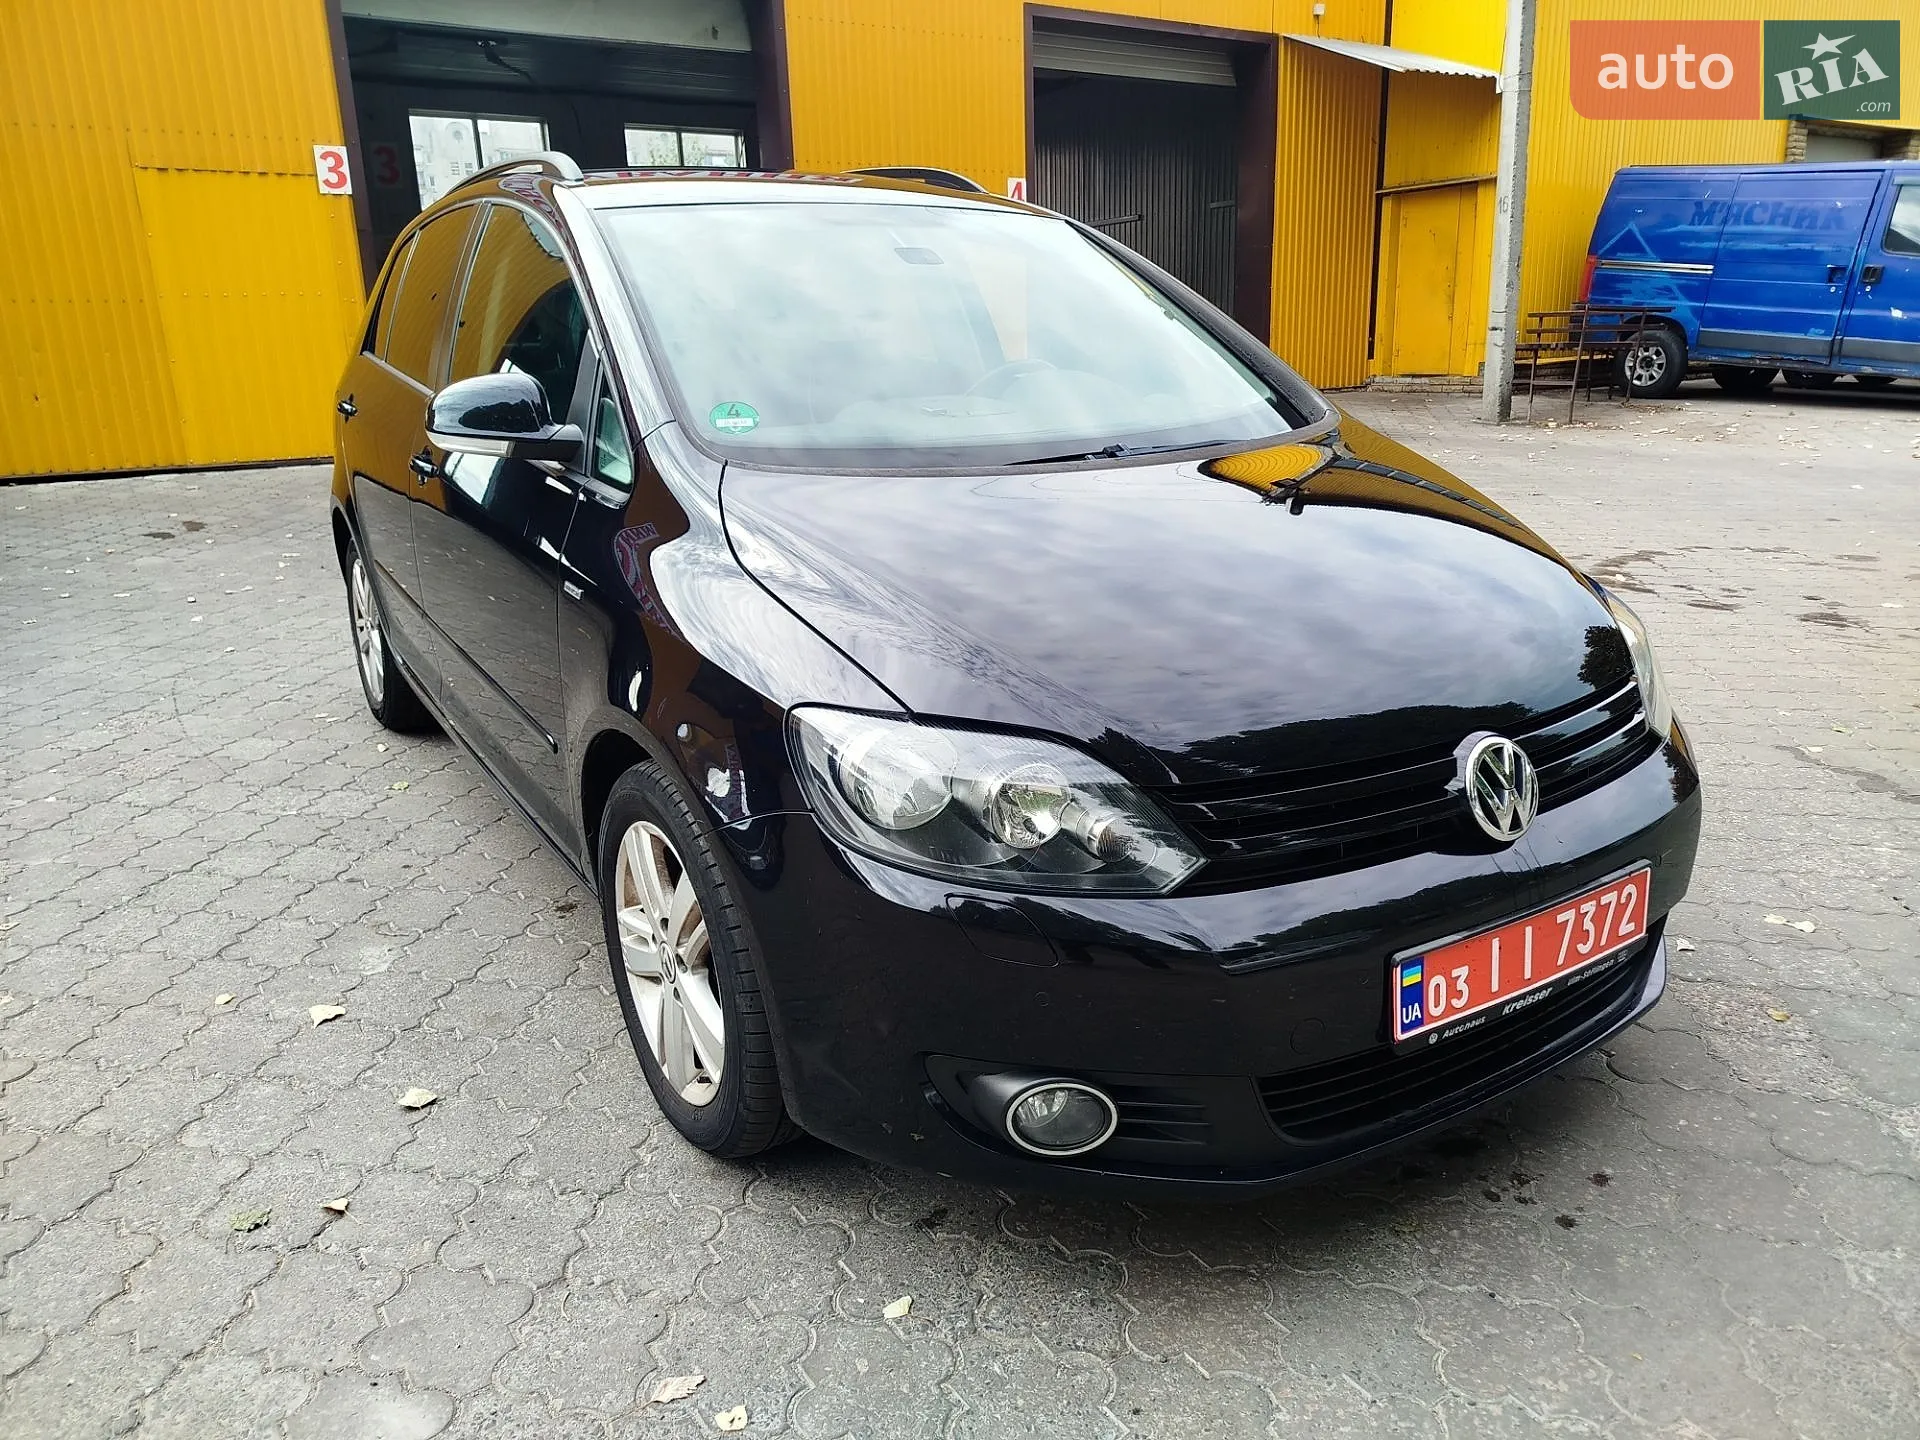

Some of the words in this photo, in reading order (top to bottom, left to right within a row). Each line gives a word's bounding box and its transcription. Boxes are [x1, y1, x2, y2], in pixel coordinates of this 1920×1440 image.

[320, 151, 348, 189] 3
[1428, 964, 1469, 1017] 03
[1556, 883, 1638, 967] 7372
[1402, 1002, 1422, 1024] UA
[1502, 987, 1553, 1016] Kreisser
